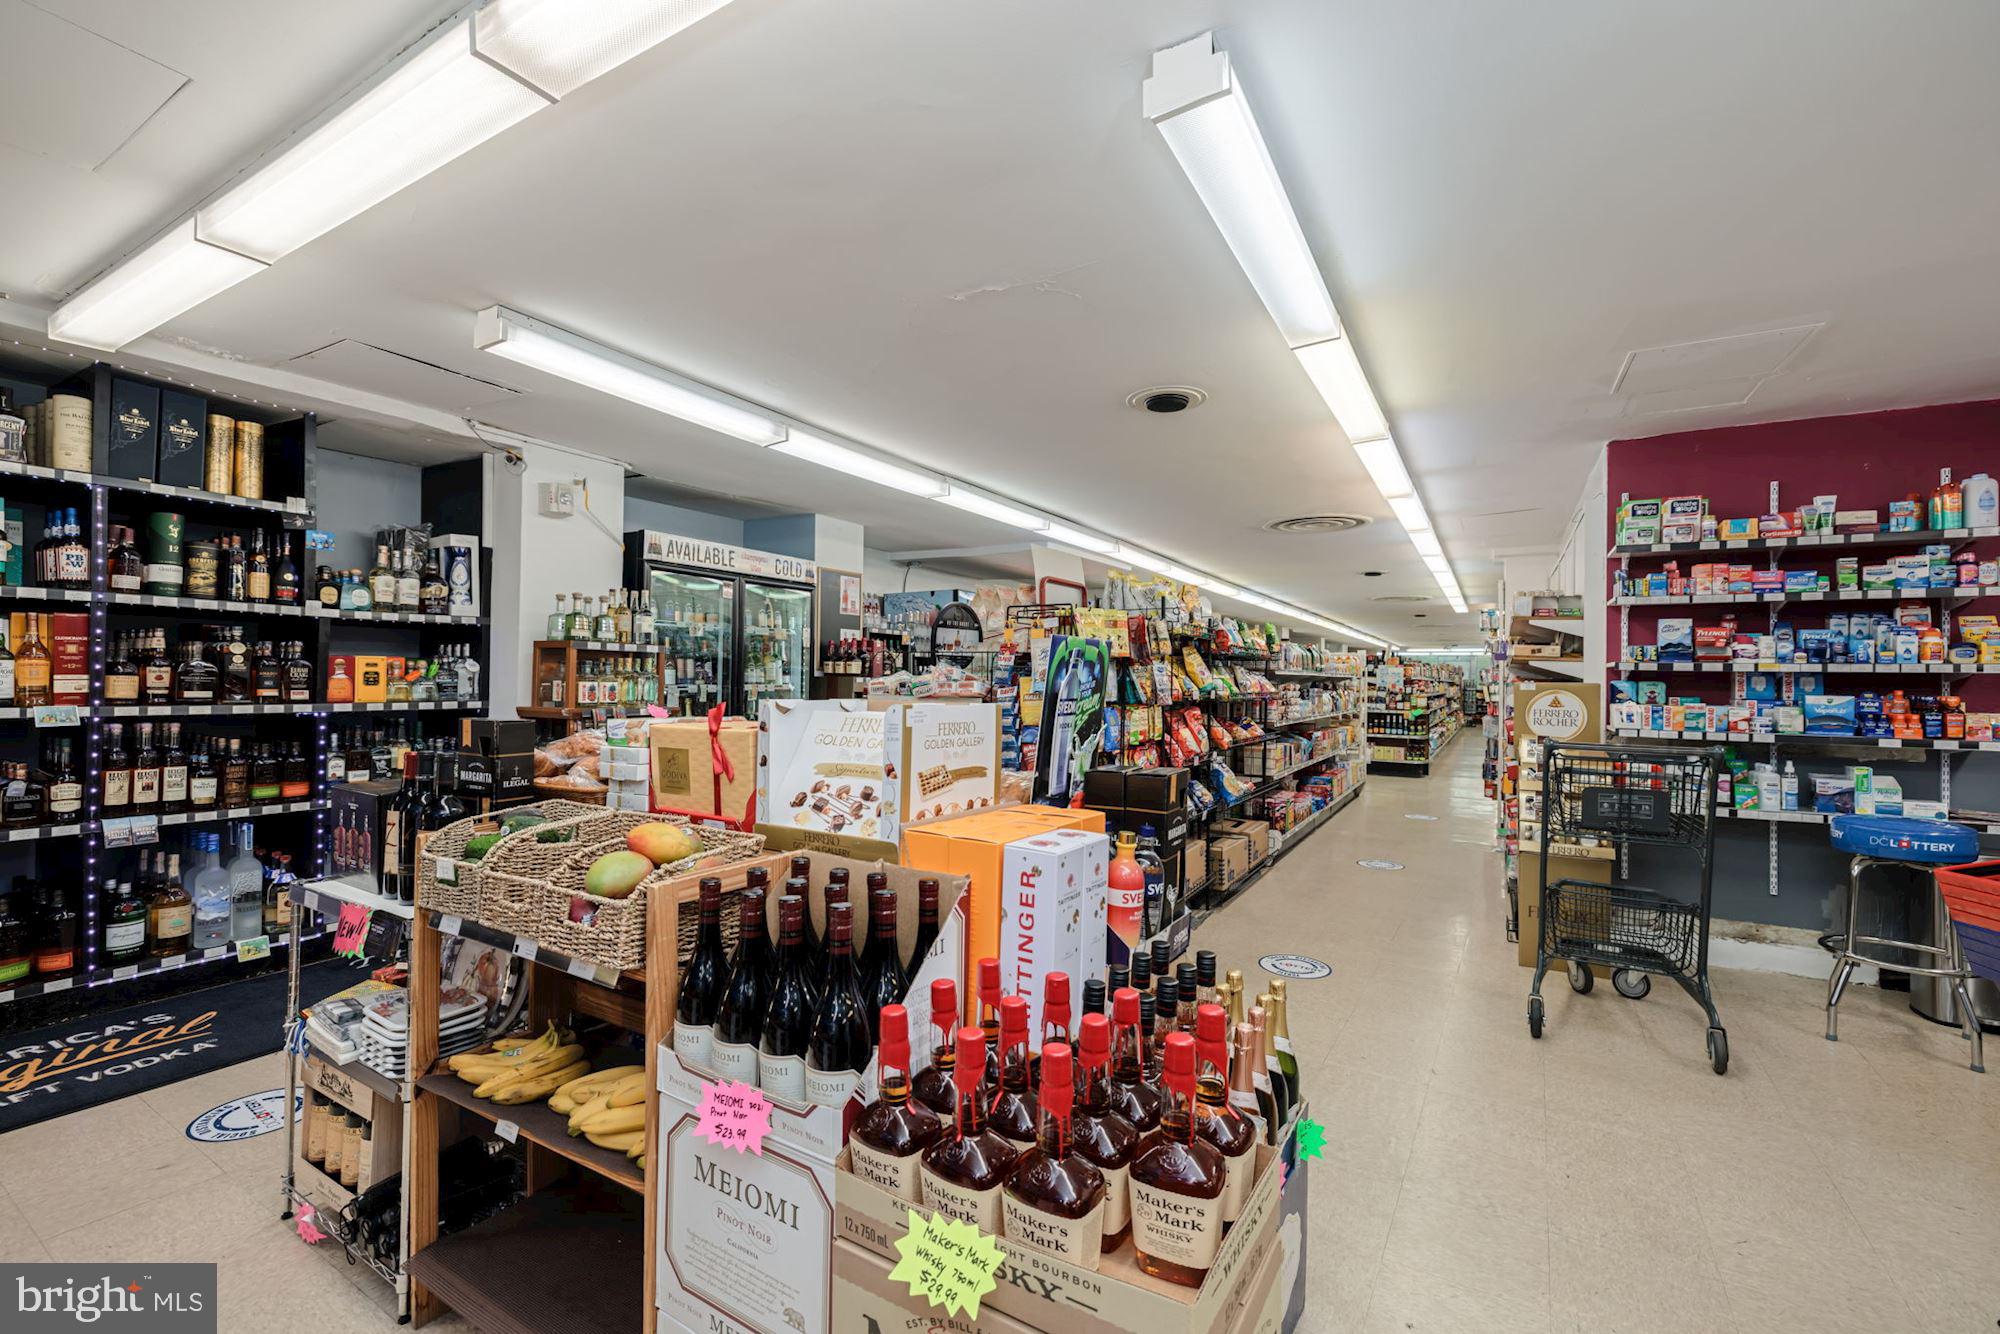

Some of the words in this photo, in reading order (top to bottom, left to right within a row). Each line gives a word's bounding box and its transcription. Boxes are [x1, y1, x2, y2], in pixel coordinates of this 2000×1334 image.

[168, 545, 179, 553] 12
[666, 539, 736, 568] AVAILABLE
[774, 558, 802, 578] COLD
[1696, 629, 1727, 637] TYLENOL
[1533, 708, 1579, 718] FERRERO
[1533, 717, 1578, 728] ROCHER
[938, 720, 976, 736] FERRERO
[815, 733, 863, 748] GOLDEN
[924, 737, 955, 750] GOLDEN
[956, 736, 985, 748] GALLERY
[460, 770, 492, 784] MARGARITA
[661, 770, 688, 781] GODIVA
[804, 832, 840, 846] FERRERO
[1869, 835, 1888, 846] DC
[1889, 838, 1956, 852] LOTTERY
[76, 1040, 219, 1083] VODKA
[713, 1092, 744, 1109] MEIOMI
[714, 1123, 747, 1140] $23.99
[851, 1147, 900, 1176] Maker's
[863, 1166, 901, 1189] Mark
[694, 1154, 801, 1231] MEIOMI
[923, 1177, 979, 1210] Maker's
[1135, 1189, 1206, 1218] Maker's
[937, 1198, 978, 1224] Mark
[1006, 1203, 1069, 1238] Maker's
[1154, 1210, 1206, 1233] Mark
[716, 1207, 744, 1231] PINOT
[747, 1223, 773, 1245] NOIR
[844, 1215, 854, 1230] 12
[860, 1223, 876, 1241] 750
[876, 1231, 889, 1249] mL
[1146, 1224, 1194, 1244] WHISKY
[727, 1238, 759, 1260] CALIFORNIA
[923, 1225, 966, 1257] Maker's
[965, 1246, 990, 1274] Mark
[1022, 1227, 1070, 1254] Mark
[916, 1245, 947, 1278] Whisky
[920, 1269, 958, 1306] $29.99
[1032, 1258, 1103, 1295] BOURBON
[906, 1318, 928, 1329] EST.
[930, 1317, 945, 1327] BY
[948, 1319, 973, 1333] BILL
